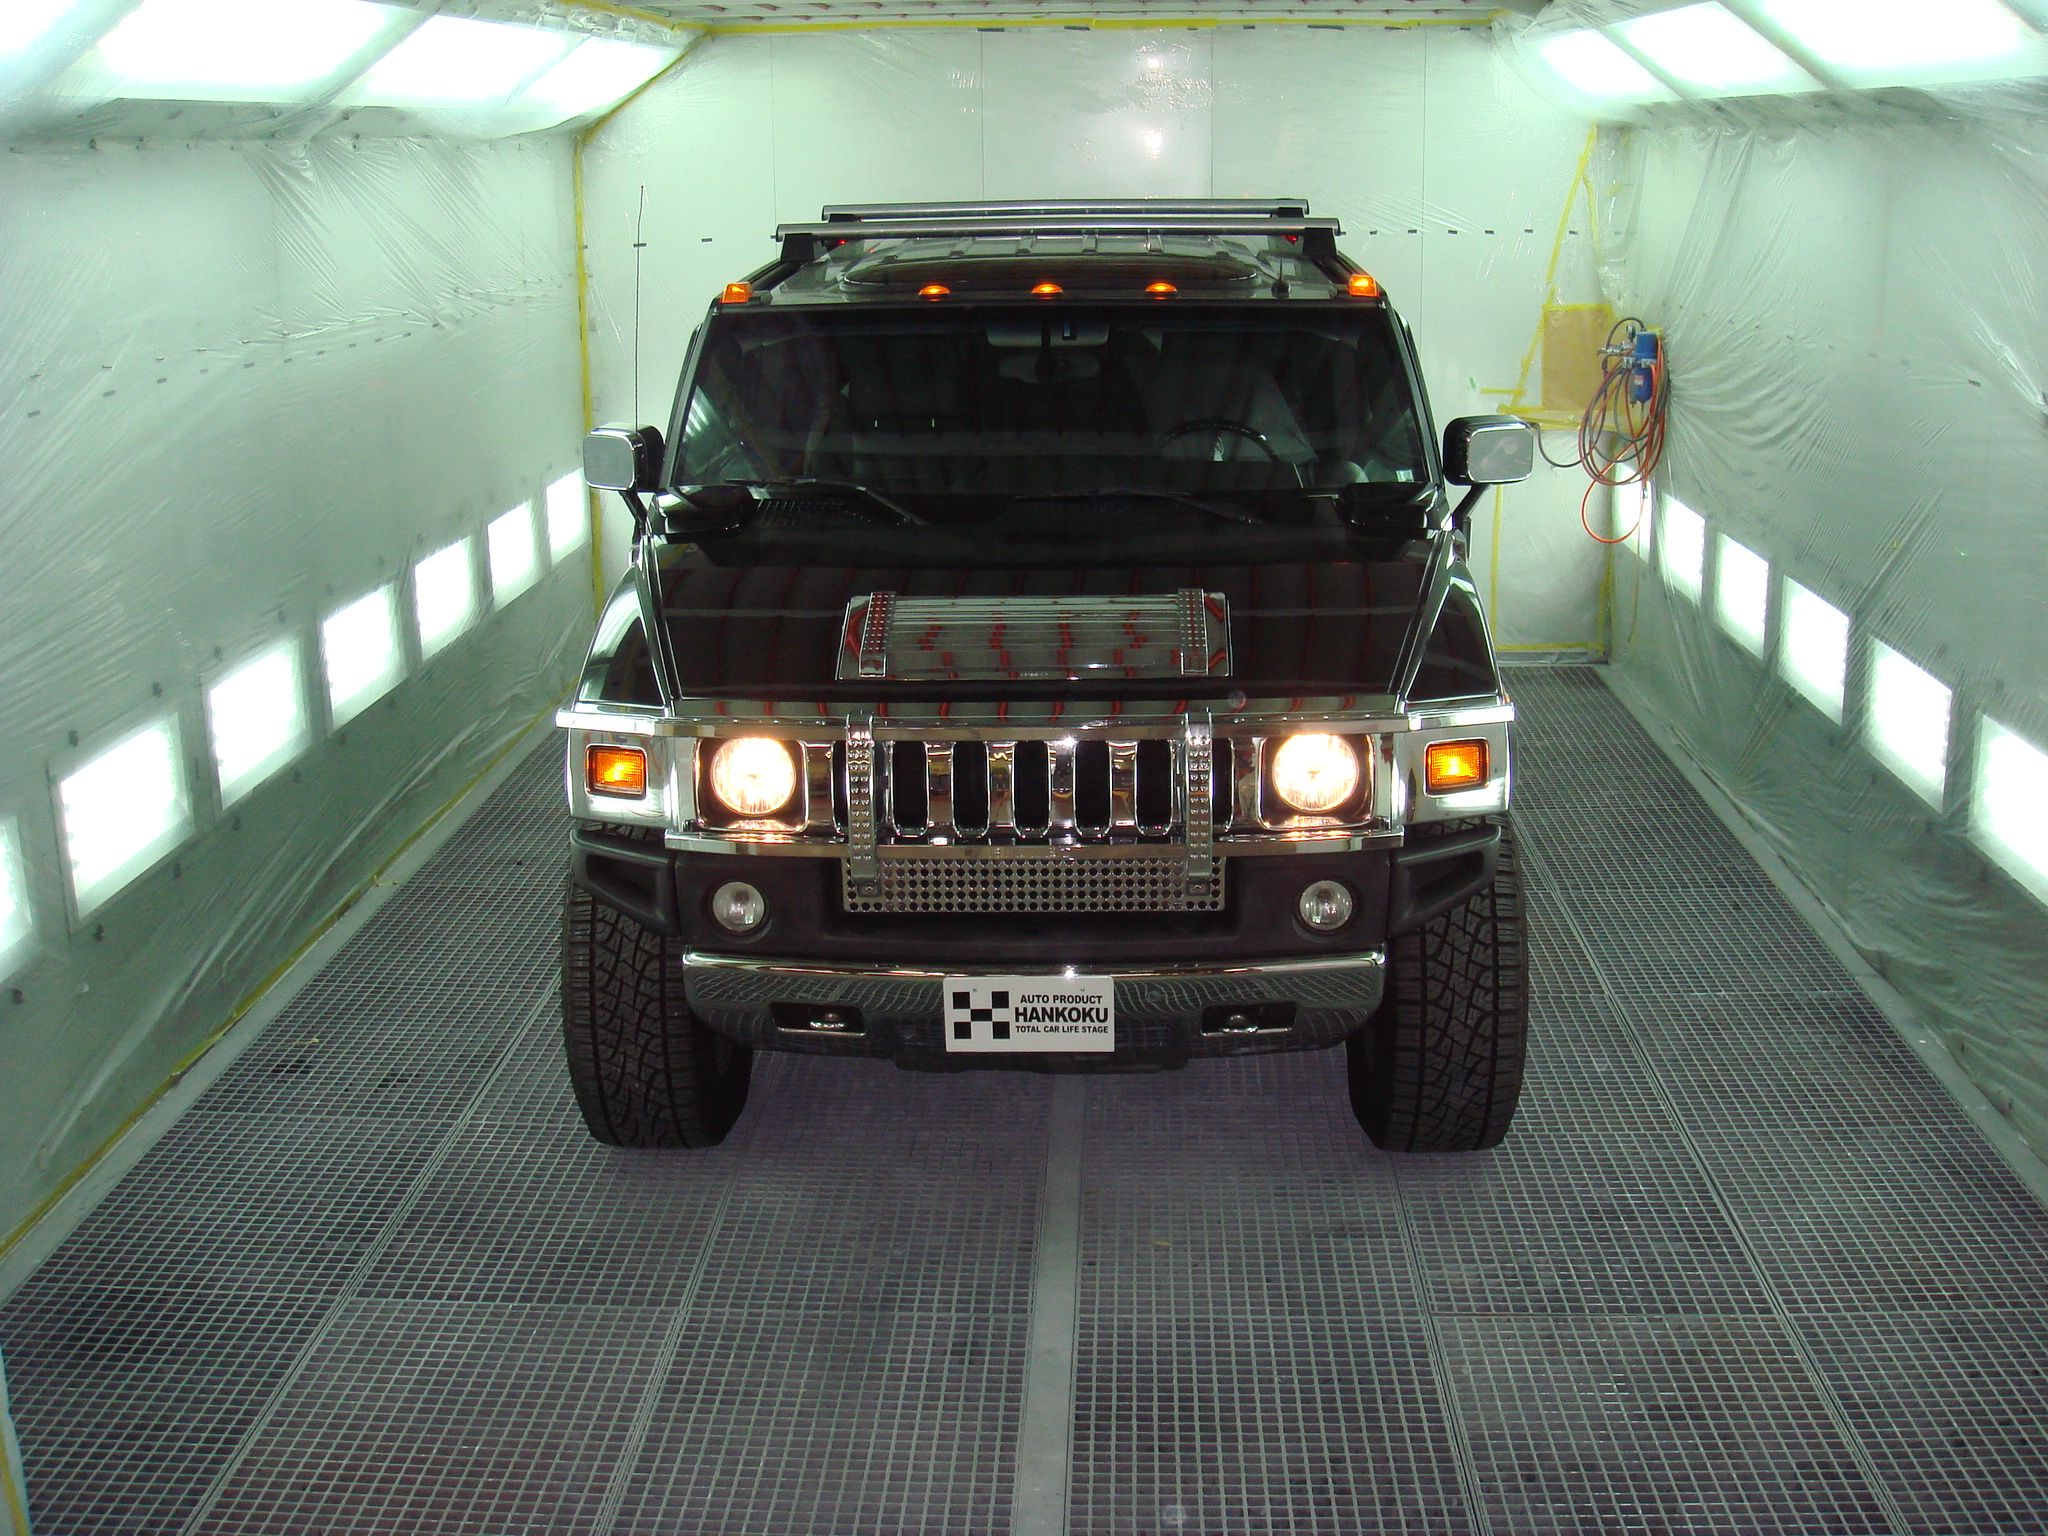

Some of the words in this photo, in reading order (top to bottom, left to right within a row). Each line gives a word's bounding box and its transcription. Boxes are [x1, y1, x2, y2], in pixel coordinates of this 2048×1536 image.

[1020, 994, 1049, 1004] AUTO
[1052, 995, 1102, 1005] PRODUCT
[1014, 1007, 1109, 1023] HANKOKU
[1016, 1025, 1041, 1033] TOTAL
[1043, 1025, 1060, 1034] CAR
[1062, 1025, 1079, 1034] LIFE
[1081, 1025, 1109, 1034] STAGE
